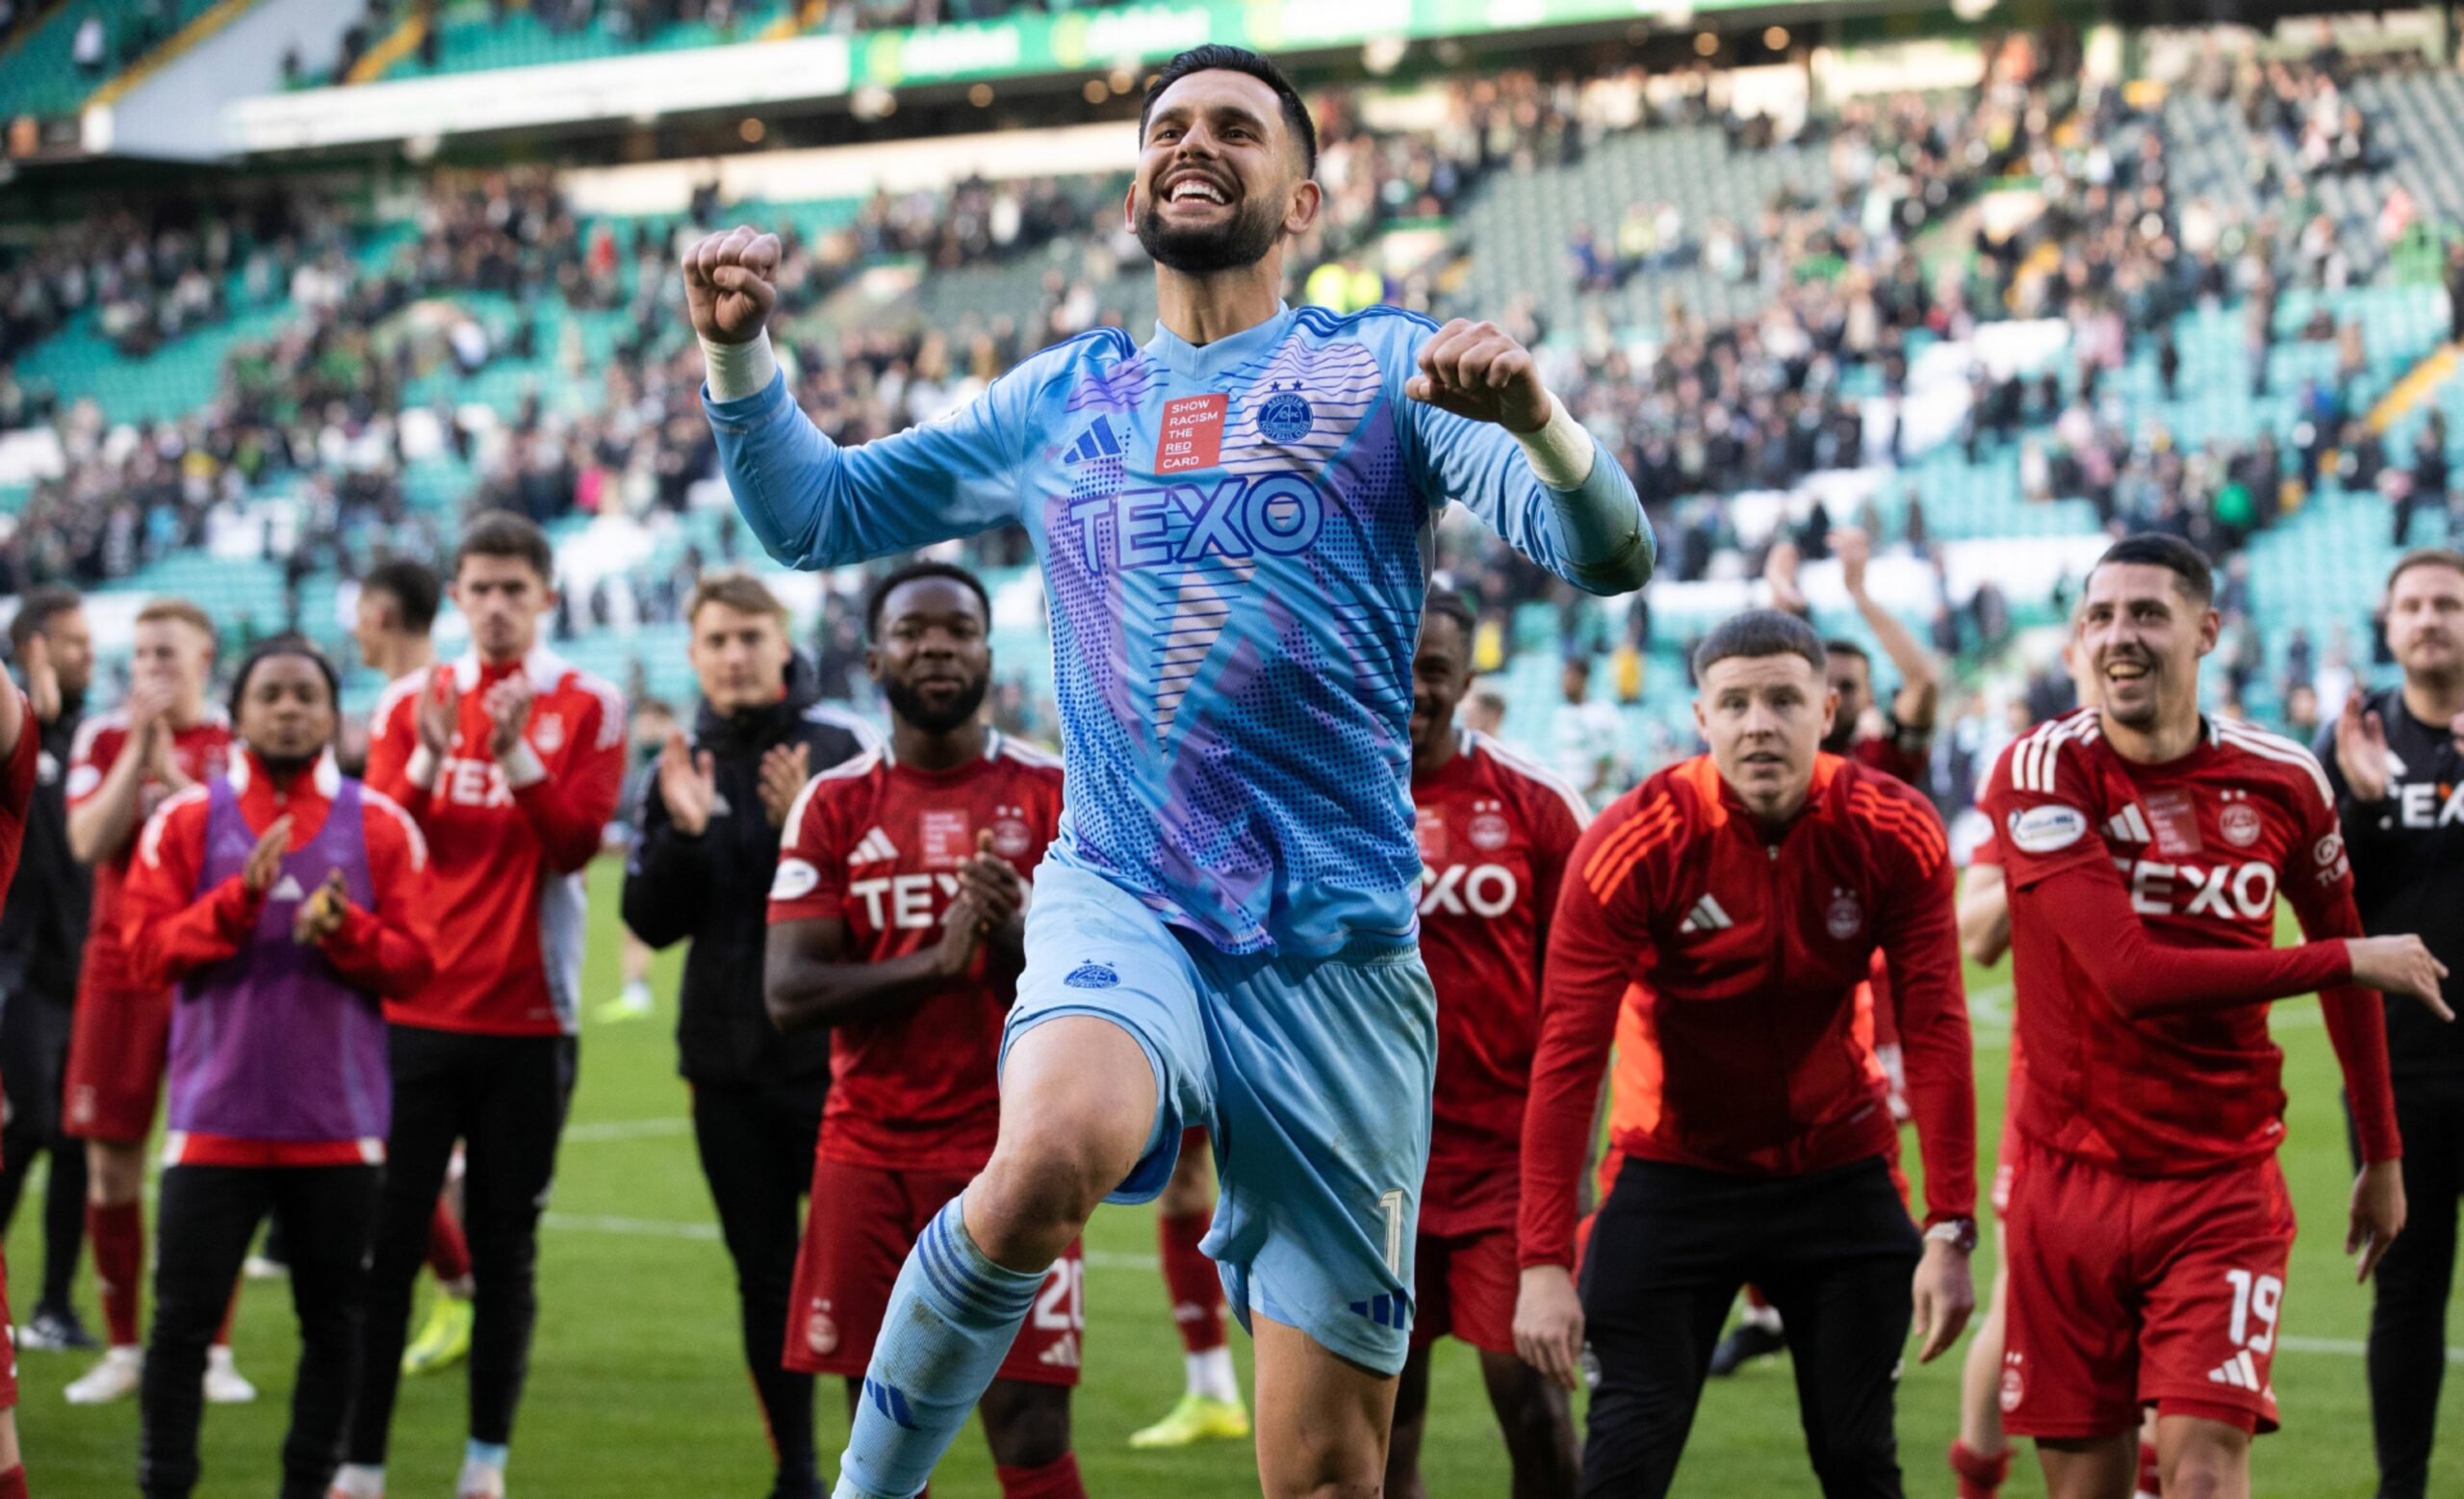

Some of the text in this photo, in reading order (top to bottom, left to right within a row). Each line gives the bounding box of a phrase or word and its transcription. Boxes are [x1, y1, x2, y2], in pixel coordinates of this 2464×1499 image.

[1171, 400, 1210, 413] SHOW
[1169, 411, 1219, 426] RACISM
[1168, 427, 1194, 439] THE
[1166, 441, 1192, 453] RED
[1163, 455, 1199, 469] CARD
[1068, 471, 1324, 577] TEXO
[2113, 857, 2275, 919] EXO
[1377, 1187, 1404, 1279] 1
[2225, 1268, 2283, 1355] 19
